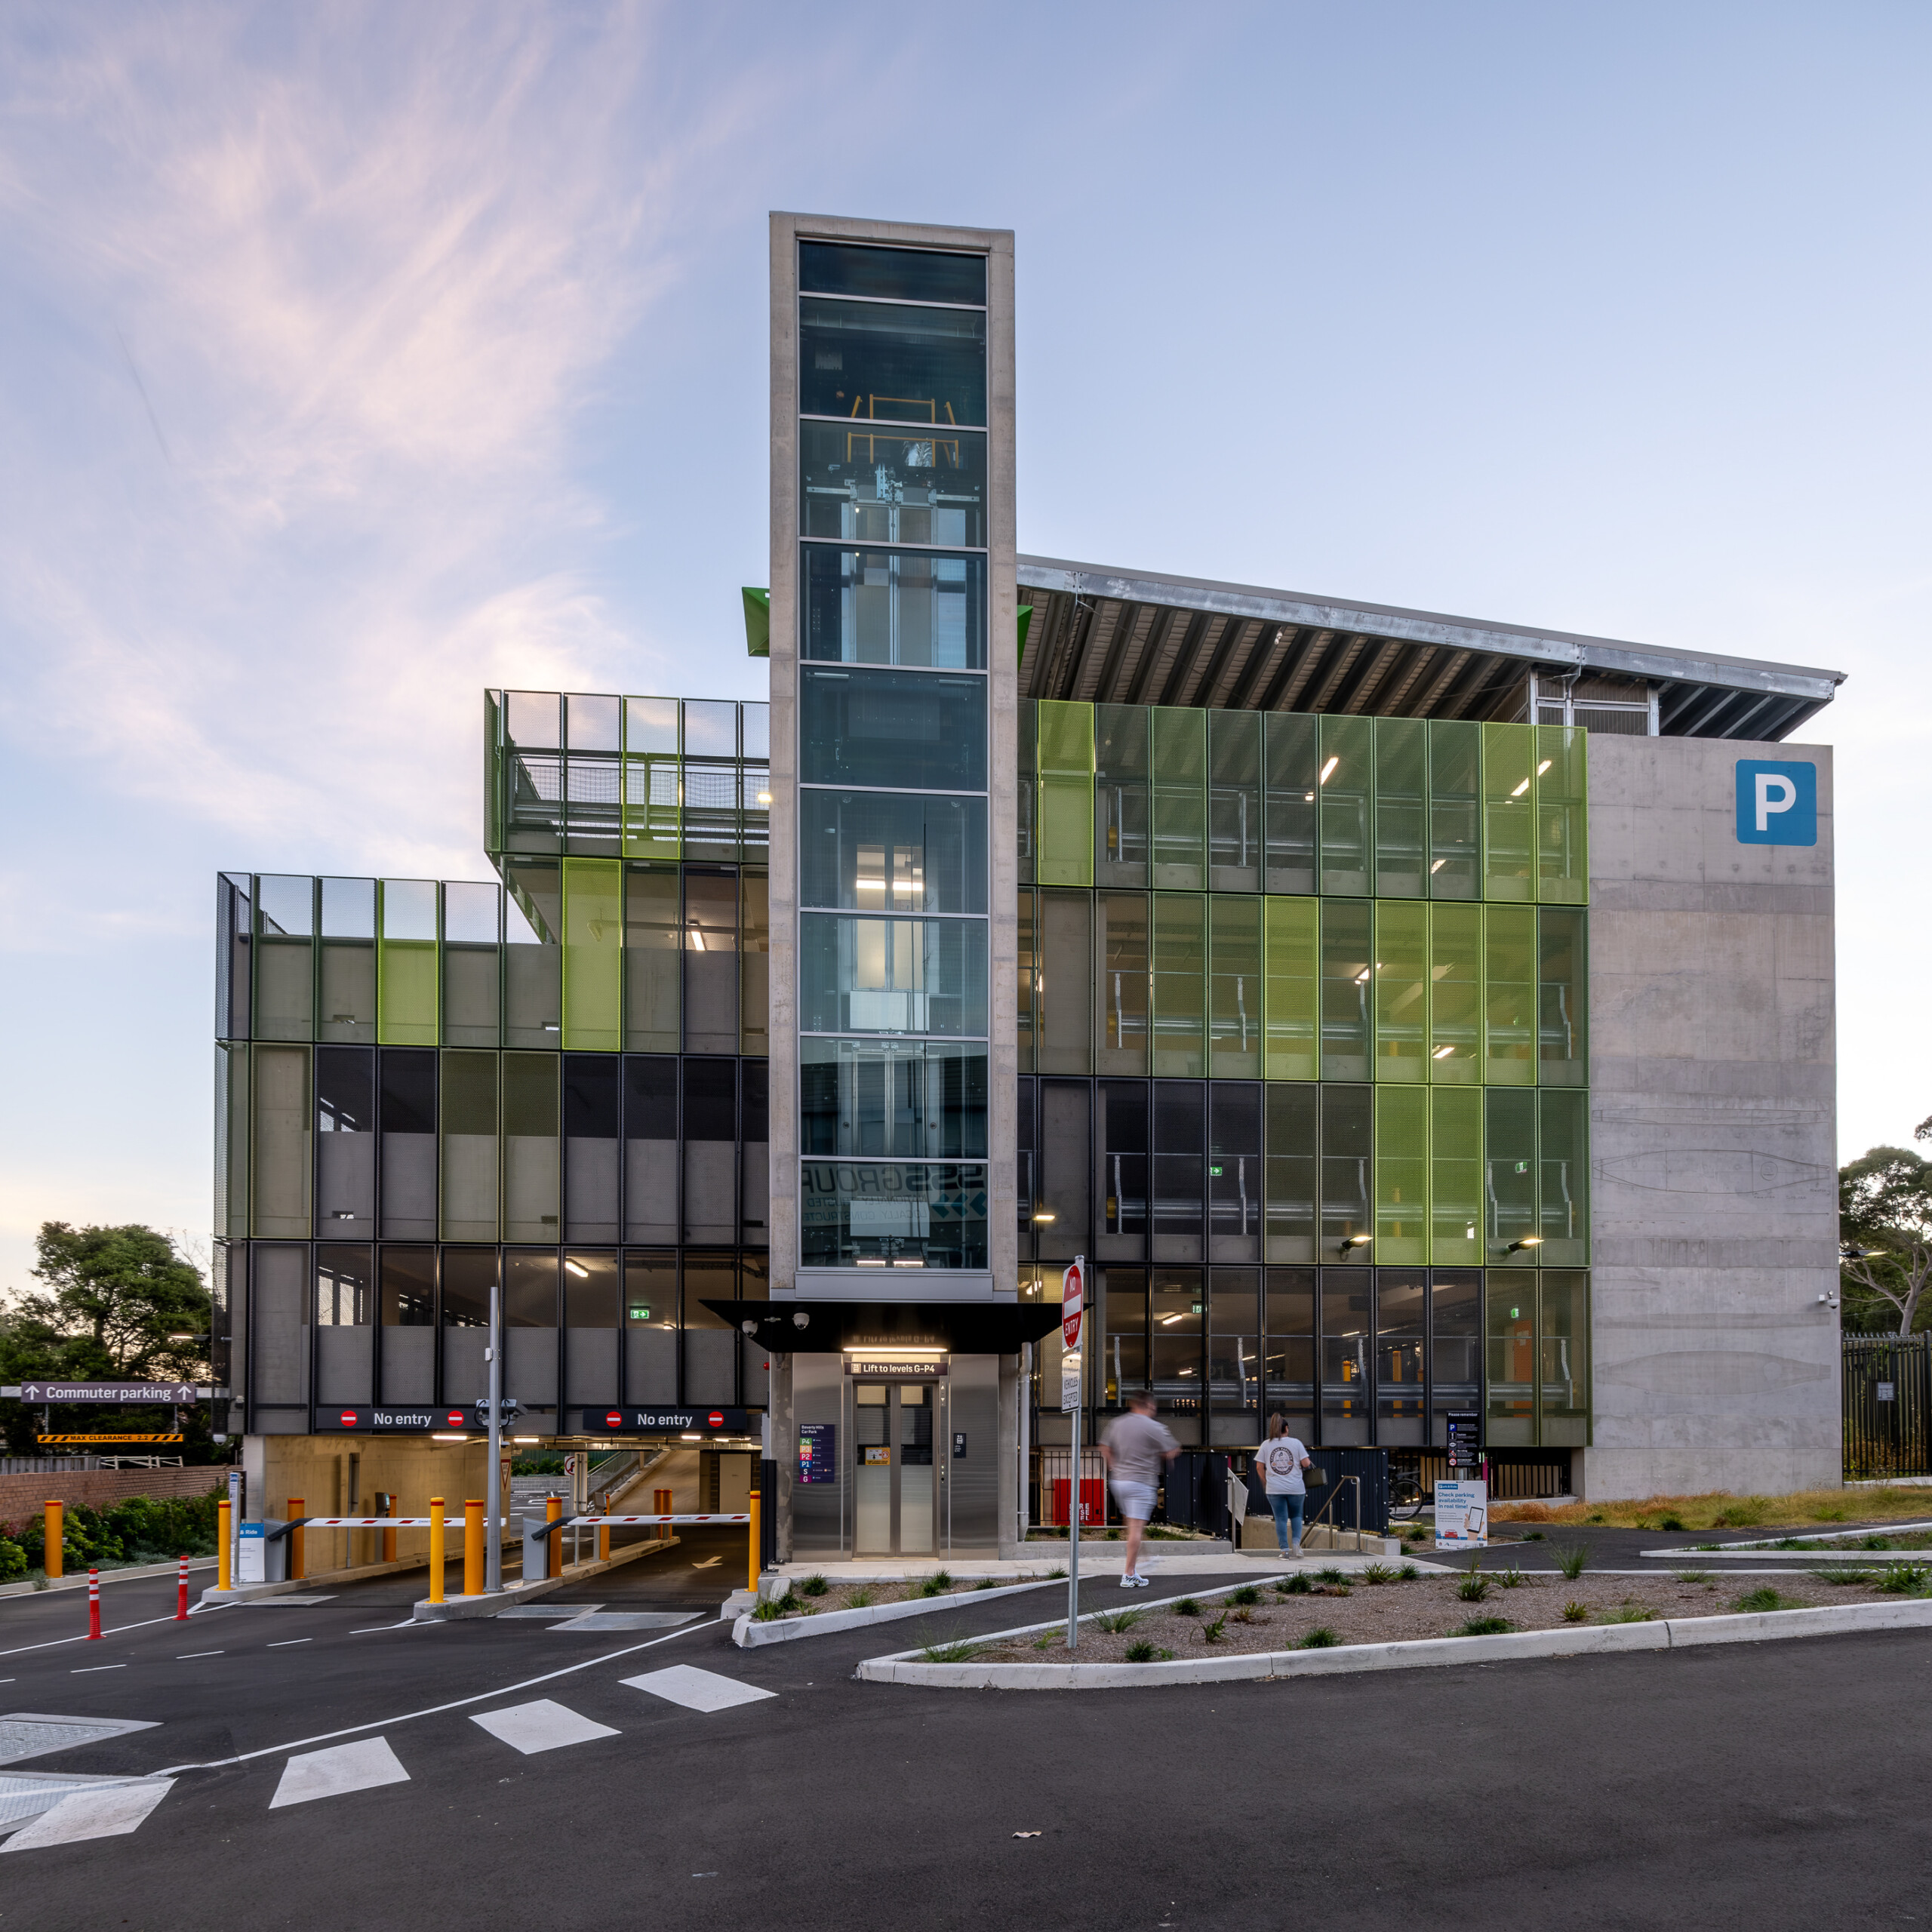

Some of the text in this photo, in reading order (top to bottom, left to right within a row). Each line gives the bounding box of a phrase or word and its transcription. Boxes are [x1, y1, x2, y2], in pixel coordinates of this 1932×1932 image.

[1755, 774, 1796, 831] P
[1069, 1276, 1076, 1293] NO
[1065, 1317, 1079, 1337] ENTRY
[863, 1364, 878, 1373] Lift
[890, 1364, 912, 1373] levels
[46, 1386, 171, 1401] Commuter parking
[1063, 1391, 1078, 1405] EXCEPTED
[374, 1413, 432, 1427] No entry
[638, 1414, 693, 1428] No entry
